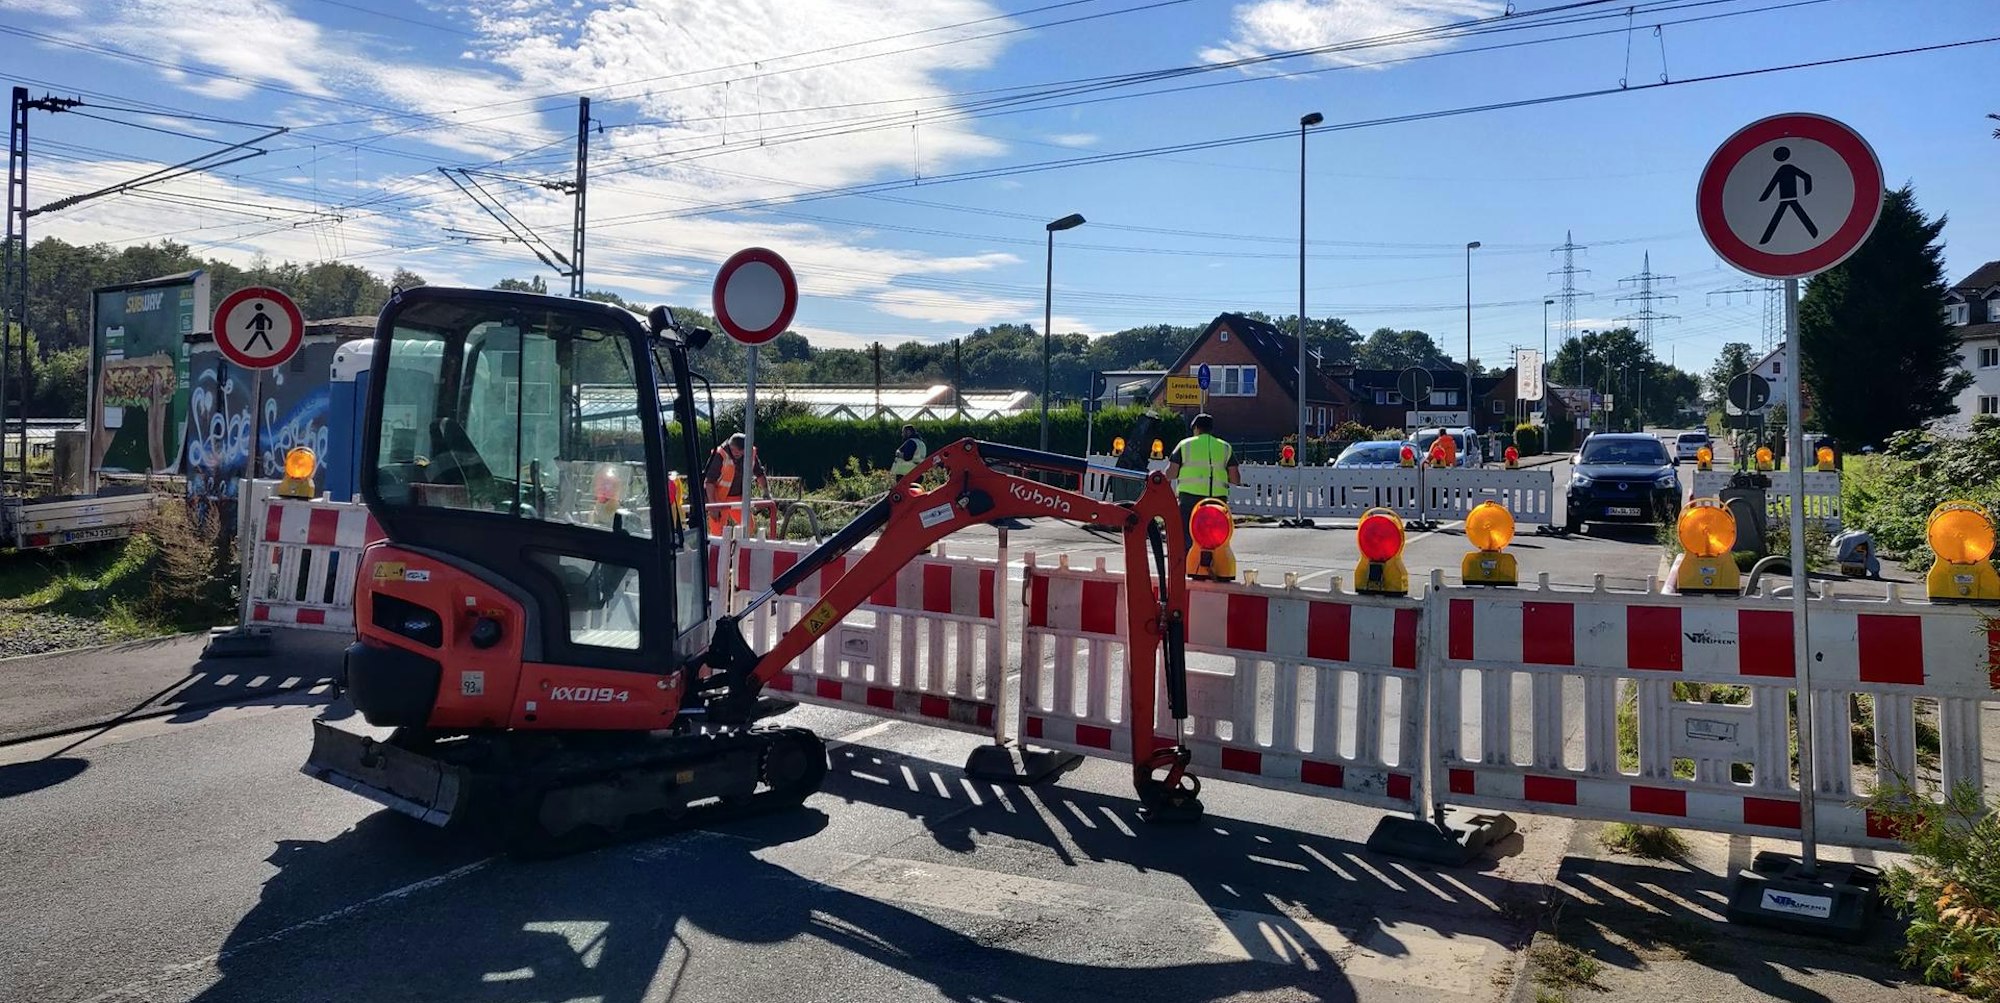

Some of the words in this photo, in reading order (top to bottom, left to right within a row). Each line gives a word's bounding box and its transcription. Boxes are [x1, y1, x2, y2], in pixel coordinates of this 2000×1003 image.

[126, 292, 163, 313] SUBWAY
[1010, 482, 1071, 514] Kubota
[550, 687, 629, 702] KX019-4
